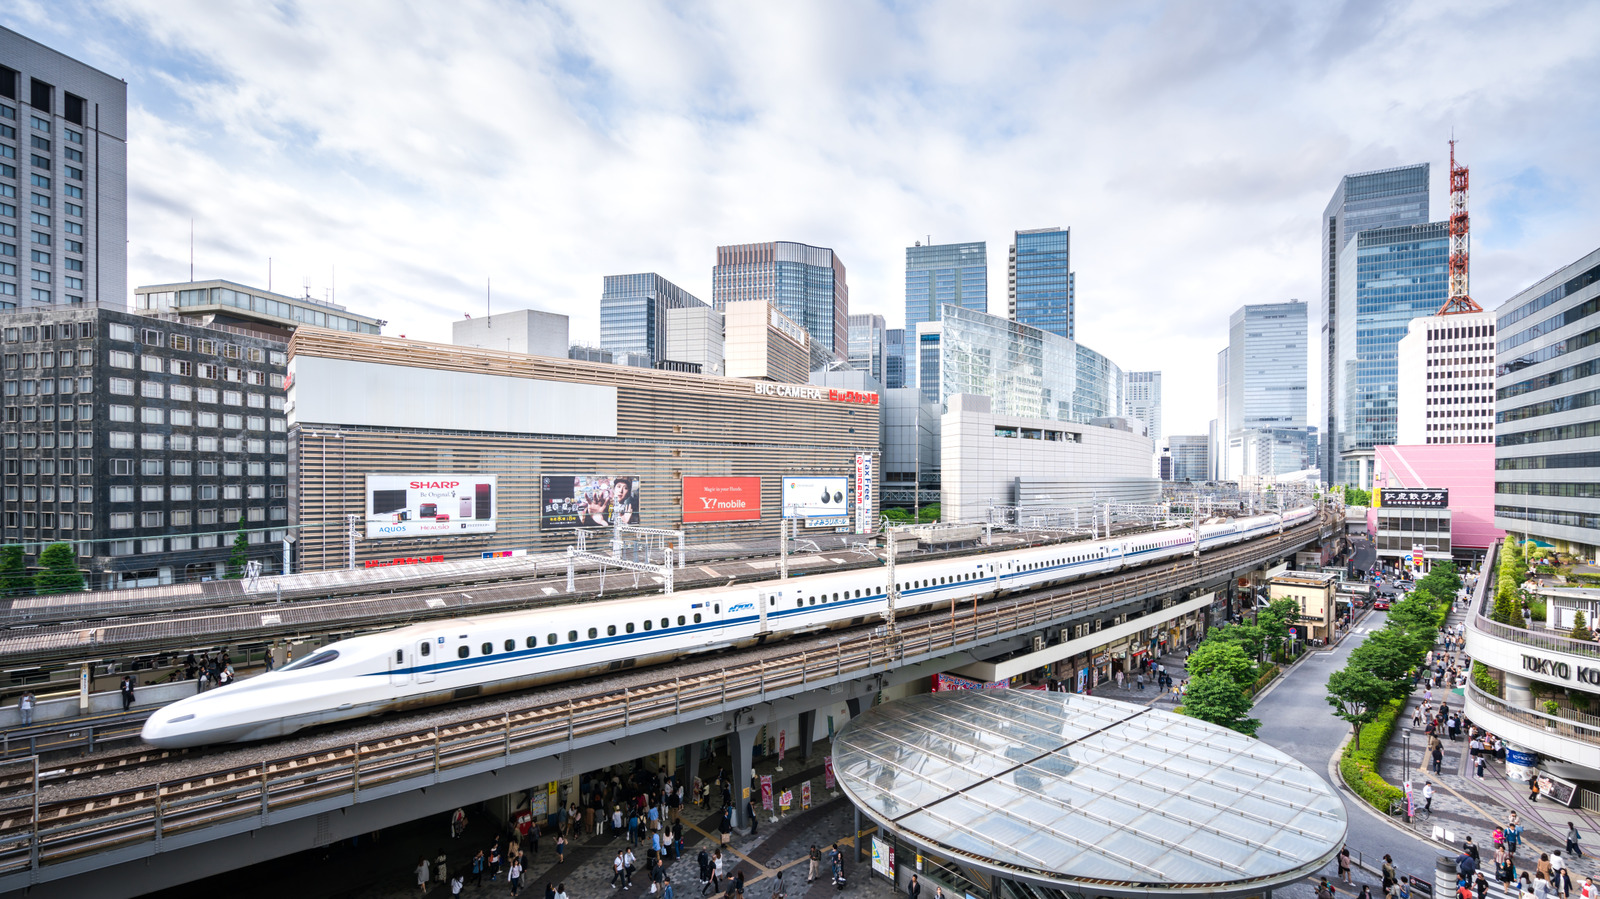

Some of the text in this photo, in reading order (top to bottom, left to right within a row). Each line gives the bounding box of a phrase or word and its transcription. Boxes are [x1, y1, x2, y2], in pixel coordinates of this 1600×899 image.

[755, 383, 821, 399] BIC CAMERA
[828, 389, 879, 405] ビックカメラ
[410, 481, 459, 489] SHARP
[1520, 653, 1570, 680] TOKYO
